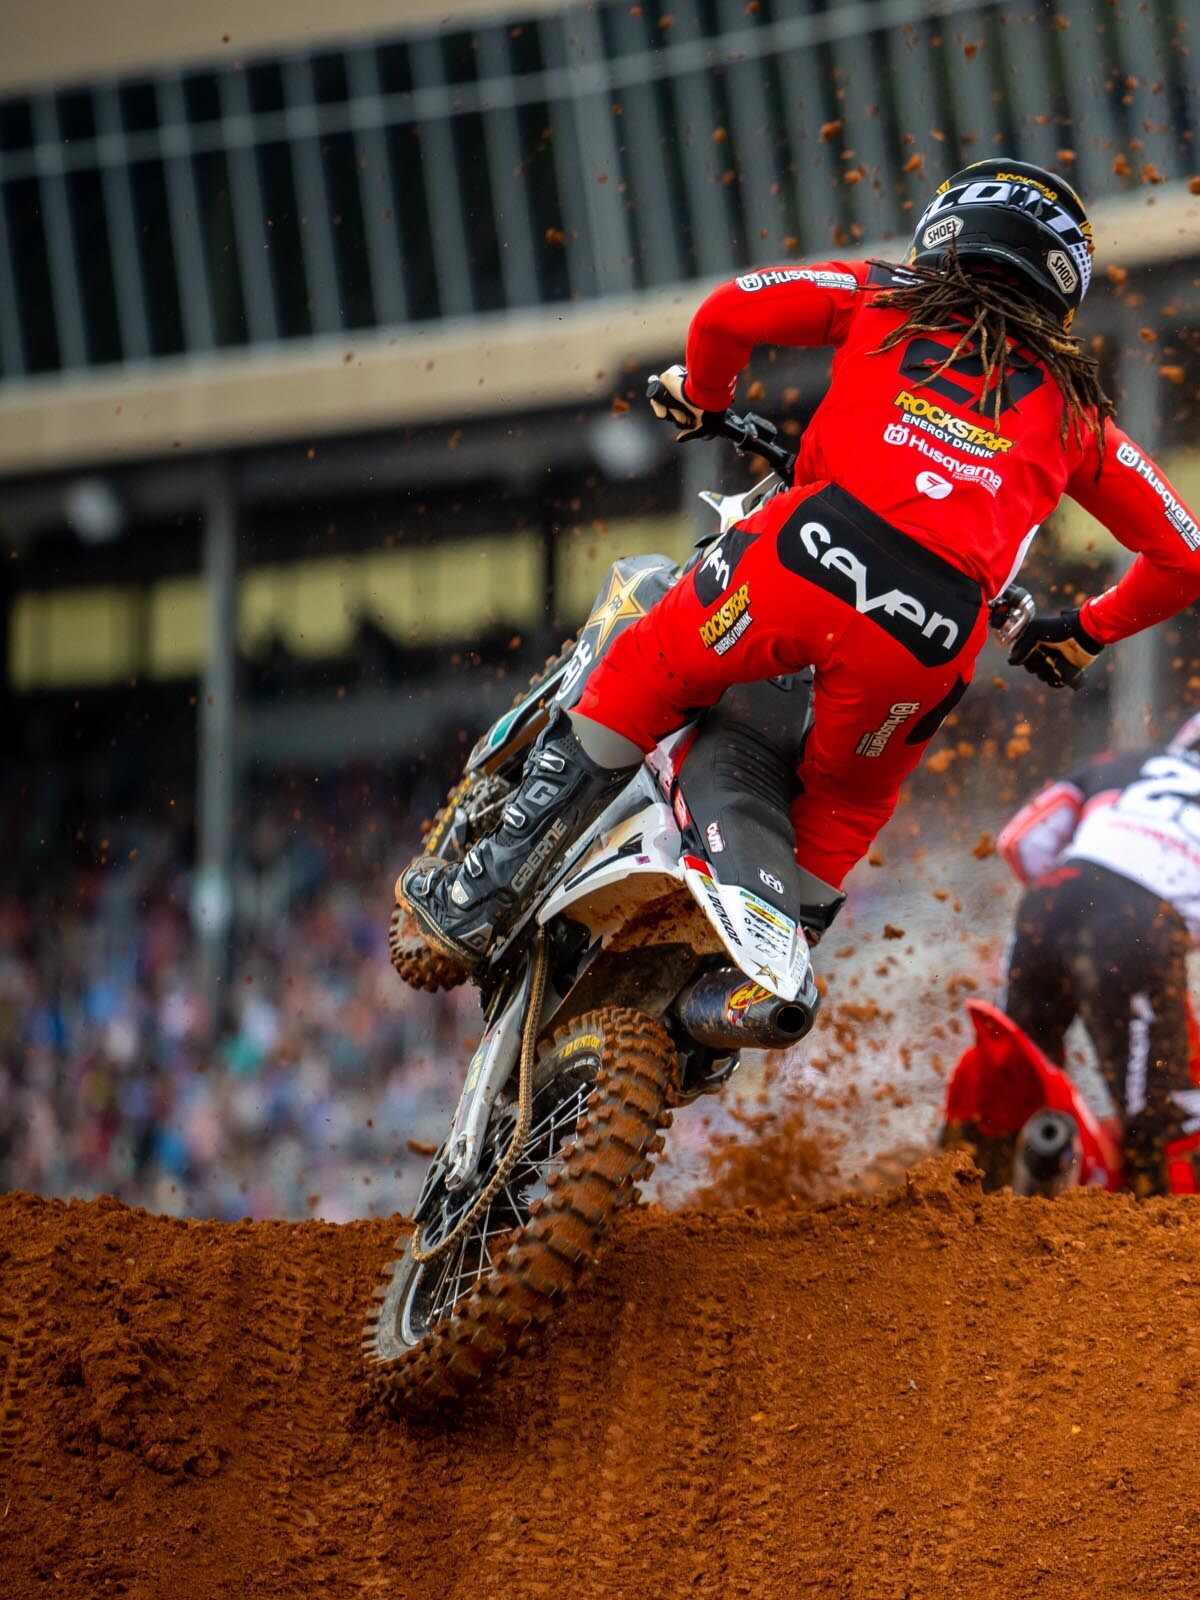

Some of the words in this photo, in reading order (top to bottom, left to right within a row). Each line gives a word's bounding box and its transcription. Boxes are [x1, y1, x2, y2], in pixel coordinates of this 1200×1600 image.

[927, 220, 958, 245] SHOEI
[763, 269, 857, 286] Husqvarna
[1051, 255, 1074, 289] SHOEI
[894, 390, 1014, 454] ROCKSTAR
[901, 412, 951, 442] ENERGY
[952, 439, 995, 459] DRINK
[908, 434, 1003, 491] Husqvarna
[699, 584, 751, 648] ROCKSTAR
[713, 631, 737, 656] ENERGY
[735, 611, 753, 639] DRINK
[866, 715, 908, 758] Husqvarna
[707, 893, 743, 947] DUNLOP
